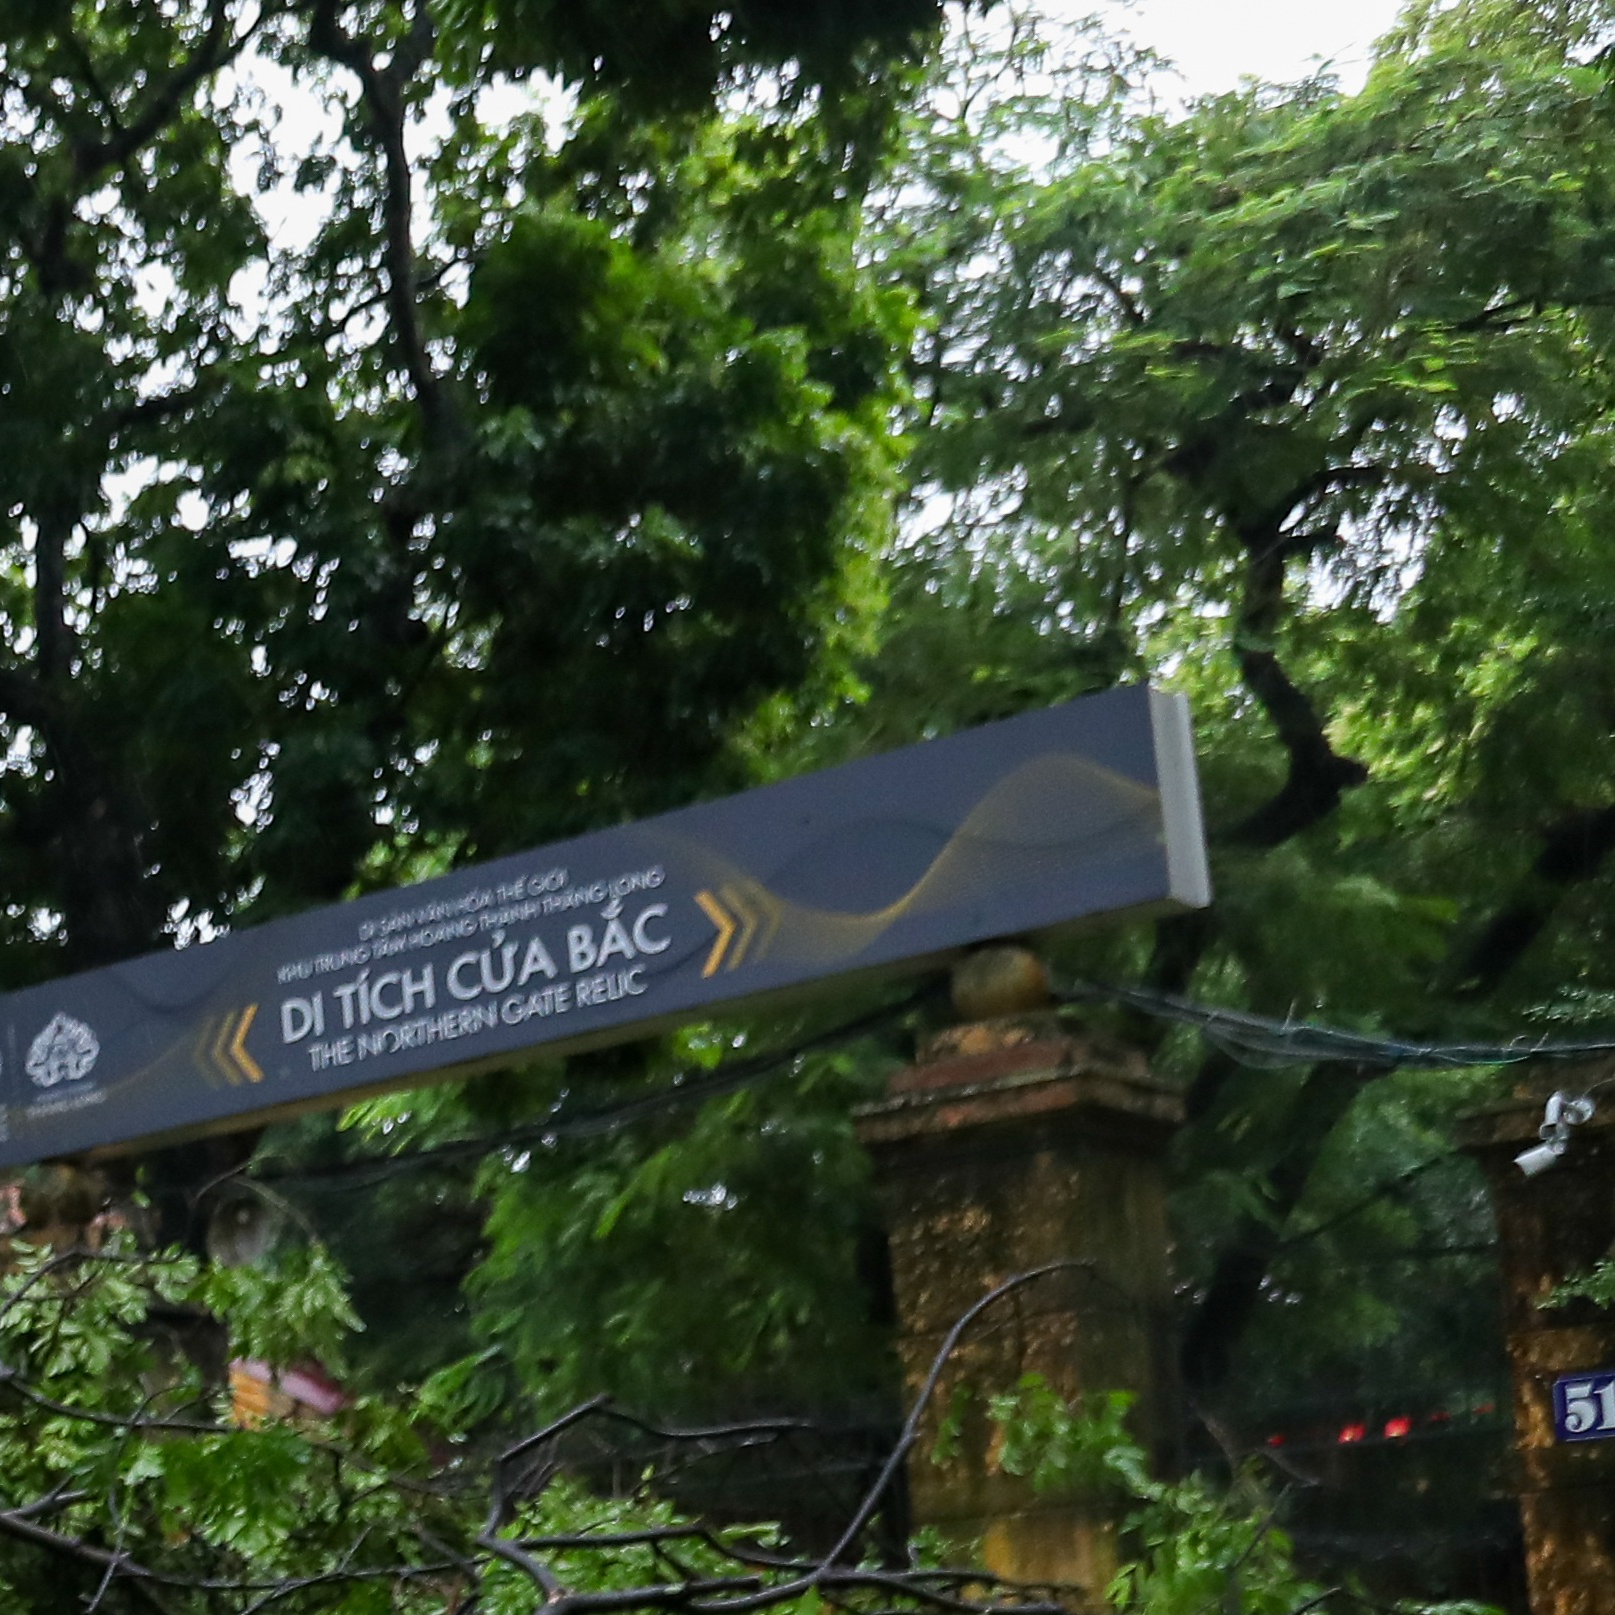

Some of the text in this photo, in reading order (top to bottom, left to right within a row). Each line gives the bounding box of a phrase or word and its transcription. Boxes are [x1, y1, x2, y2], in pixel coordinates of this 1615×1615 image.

[608, 864, 667, 899] LONG
[280, 897, 672, 1045] DI TÍCH CỬA BẮC
[307, 963, 650, 1073] THE NORTHERN GATE RELIC
[1565, 1381, 1615, 1434] 51
